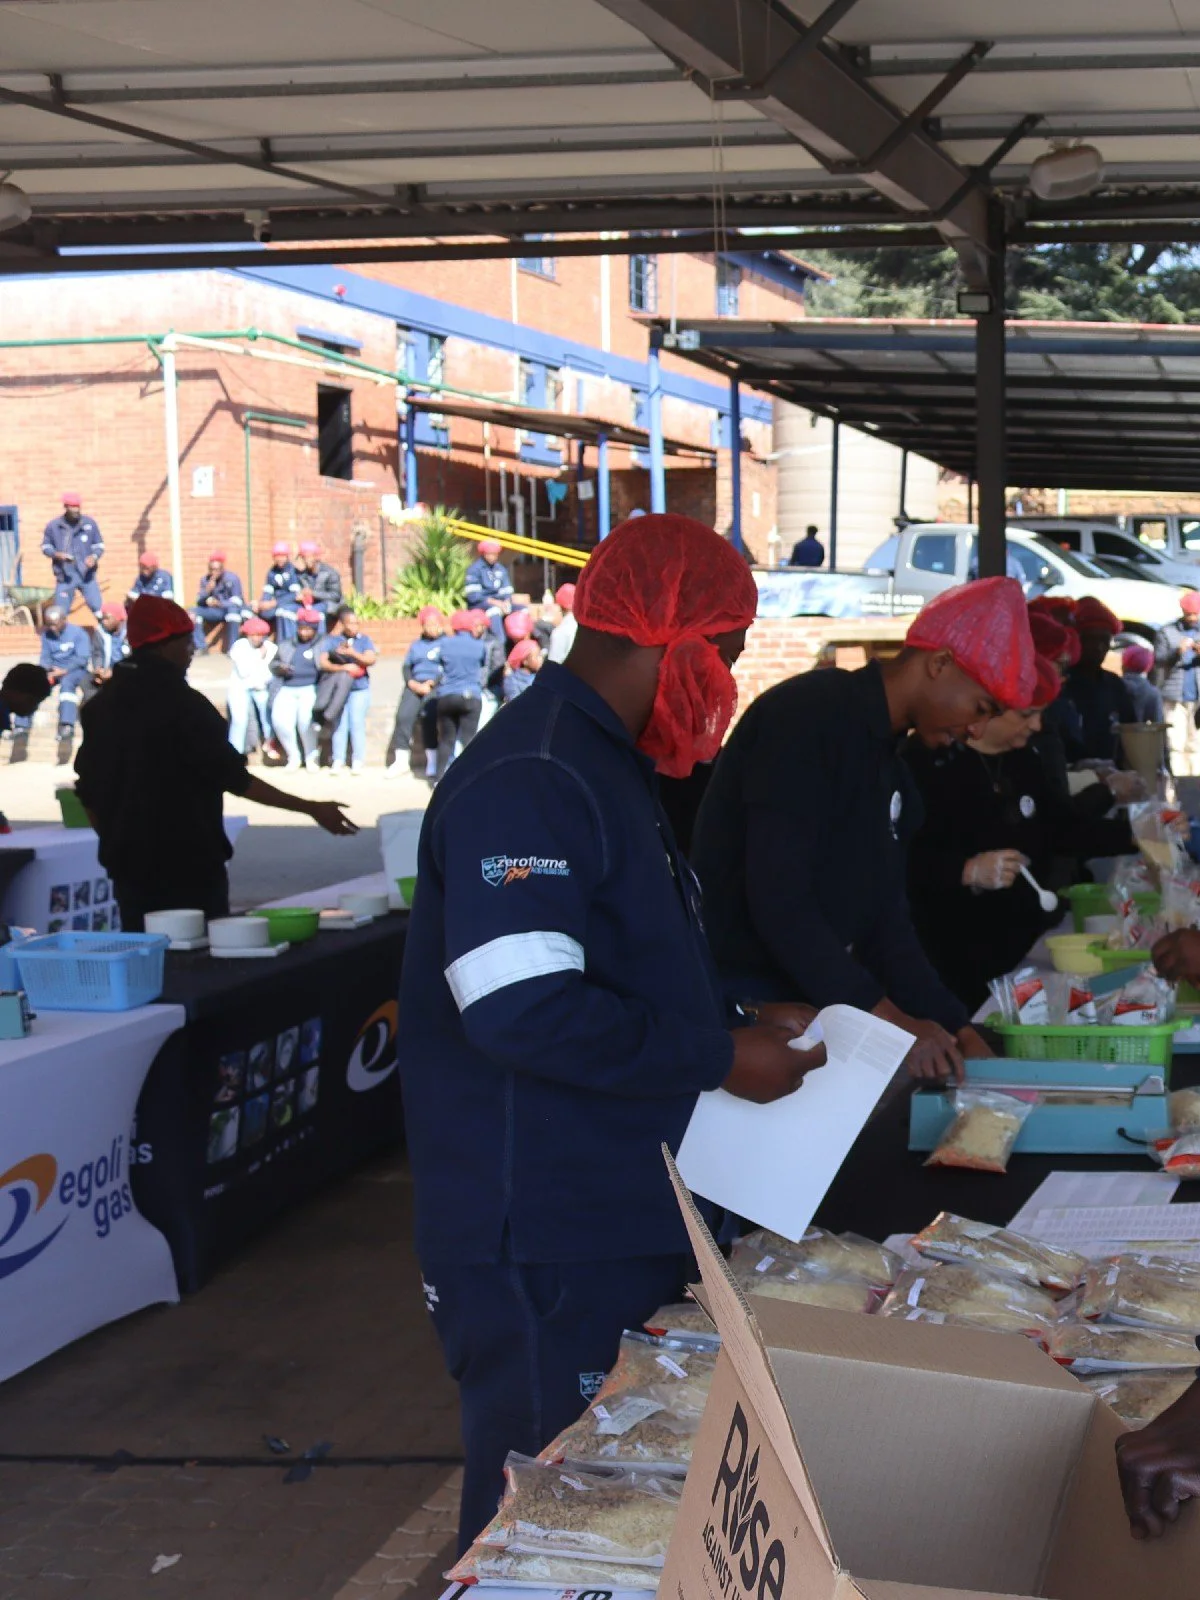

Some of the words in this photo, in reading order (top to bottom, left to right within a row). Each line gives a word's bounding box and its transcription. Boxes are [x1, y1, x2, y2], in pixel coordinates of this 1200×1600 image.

[496, 856, 567, 869] zeroflame
[59, 1135, 124, 1209] egoli
[94, 1183, 132, 1238] gas
[701, 1516, 733, 1598] AGAINST
